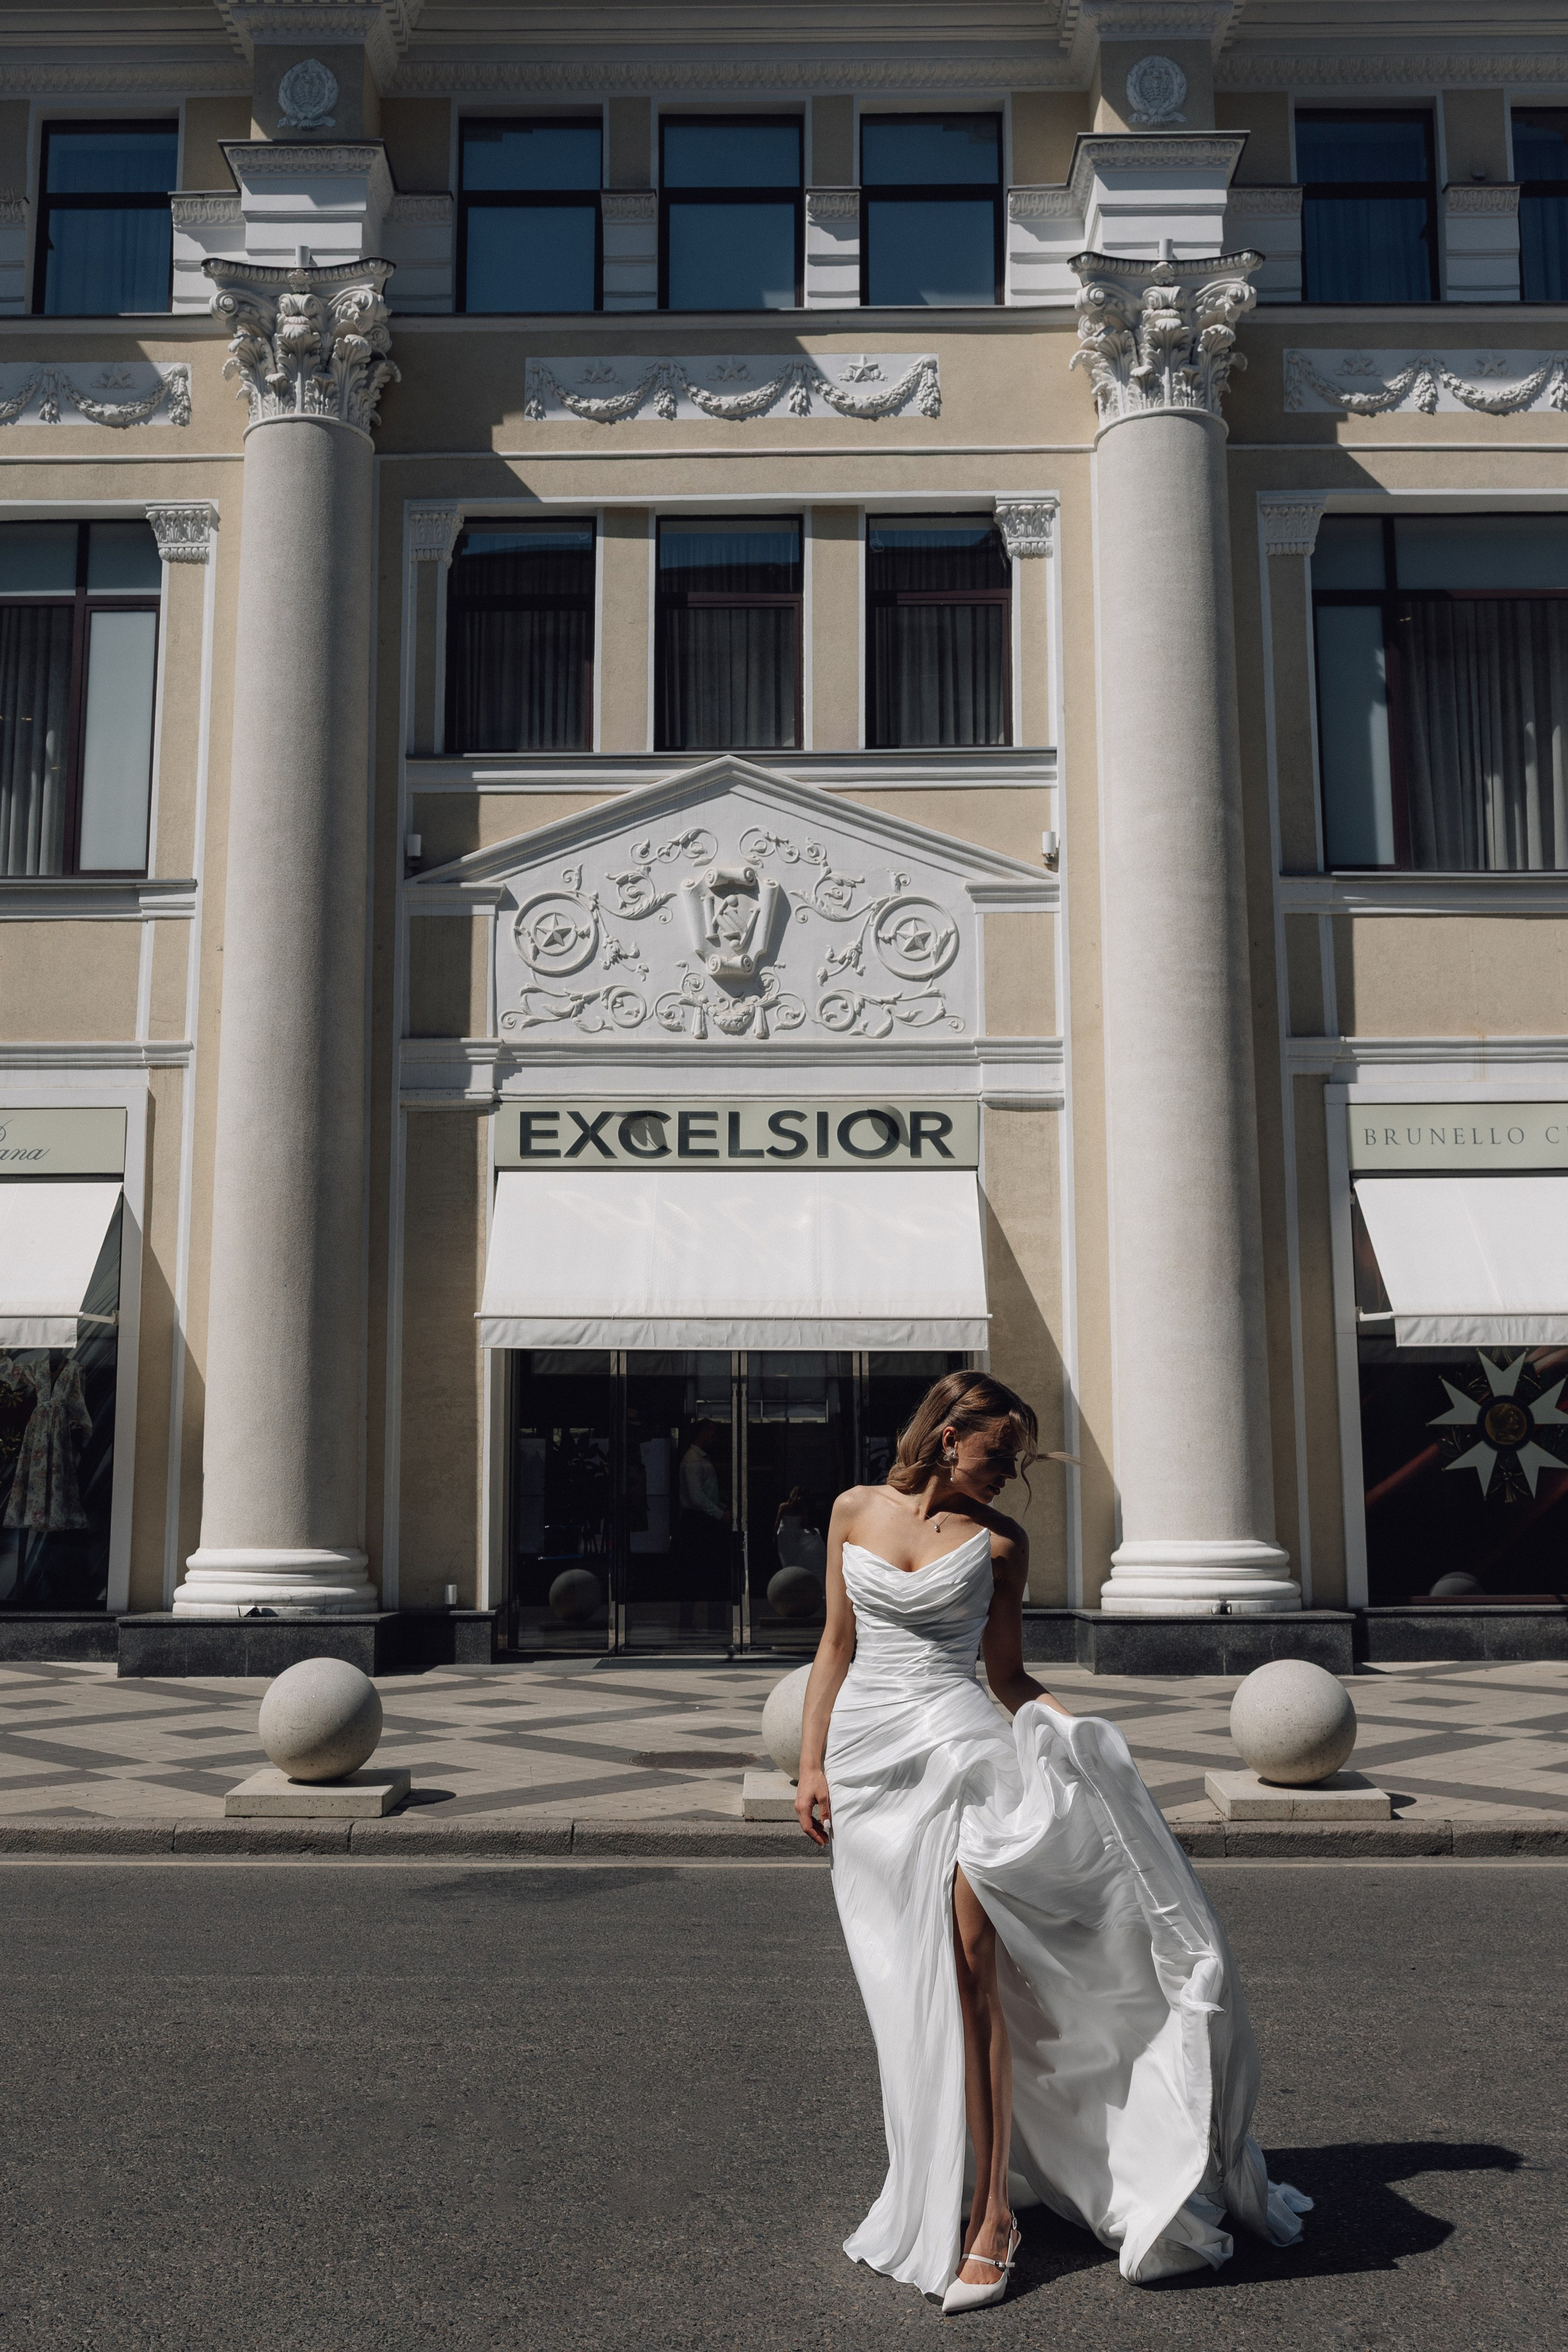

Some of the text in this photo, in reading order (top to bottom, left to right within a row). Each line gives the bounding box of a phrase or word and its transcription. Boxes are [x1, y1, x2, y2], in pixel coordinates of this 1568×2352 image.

[519, 1109, 956, 1159] EXCELSIOR
[1364, 1126, 1568, 1145] BRUNELLO C
